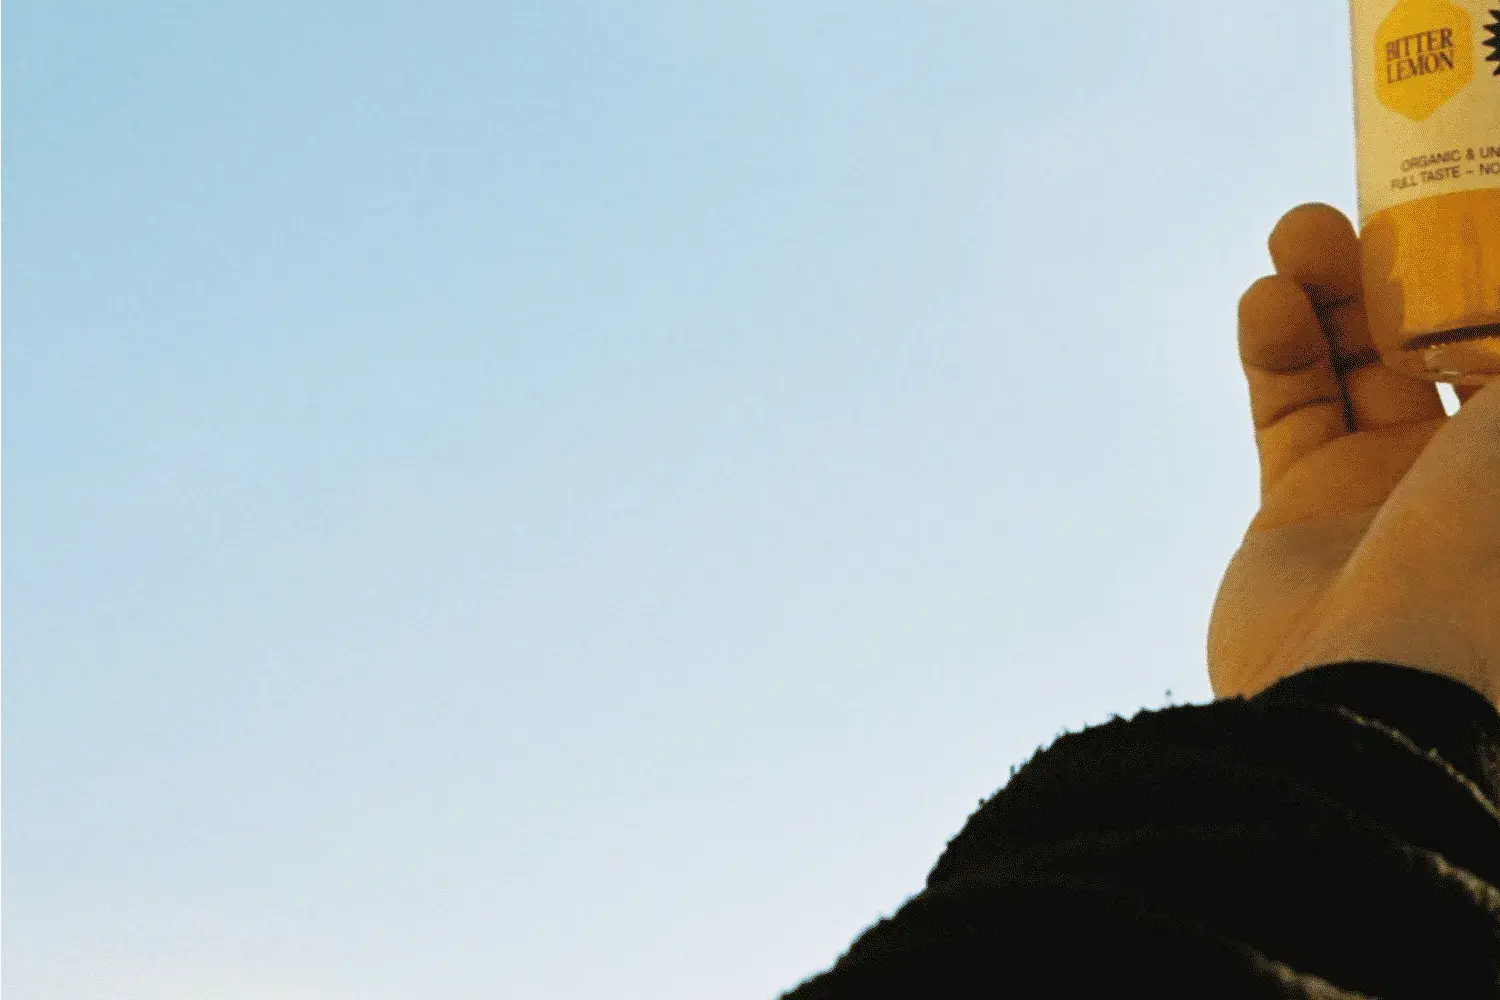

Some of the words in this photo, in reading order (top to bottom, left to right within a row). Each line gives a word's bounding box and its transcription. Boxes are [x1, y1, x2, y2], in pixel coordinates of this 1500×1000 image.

[1385, 27, 1455, 62] BITTER
[1386, 50, 1455, 85] LEMON
[1401, 149, 1462, 172] ORGANIC
[1465, 147, 1475, 161] &
[1420, 165, 1462, 183] TASTE
[1479, 161, 1500, 176] NO
